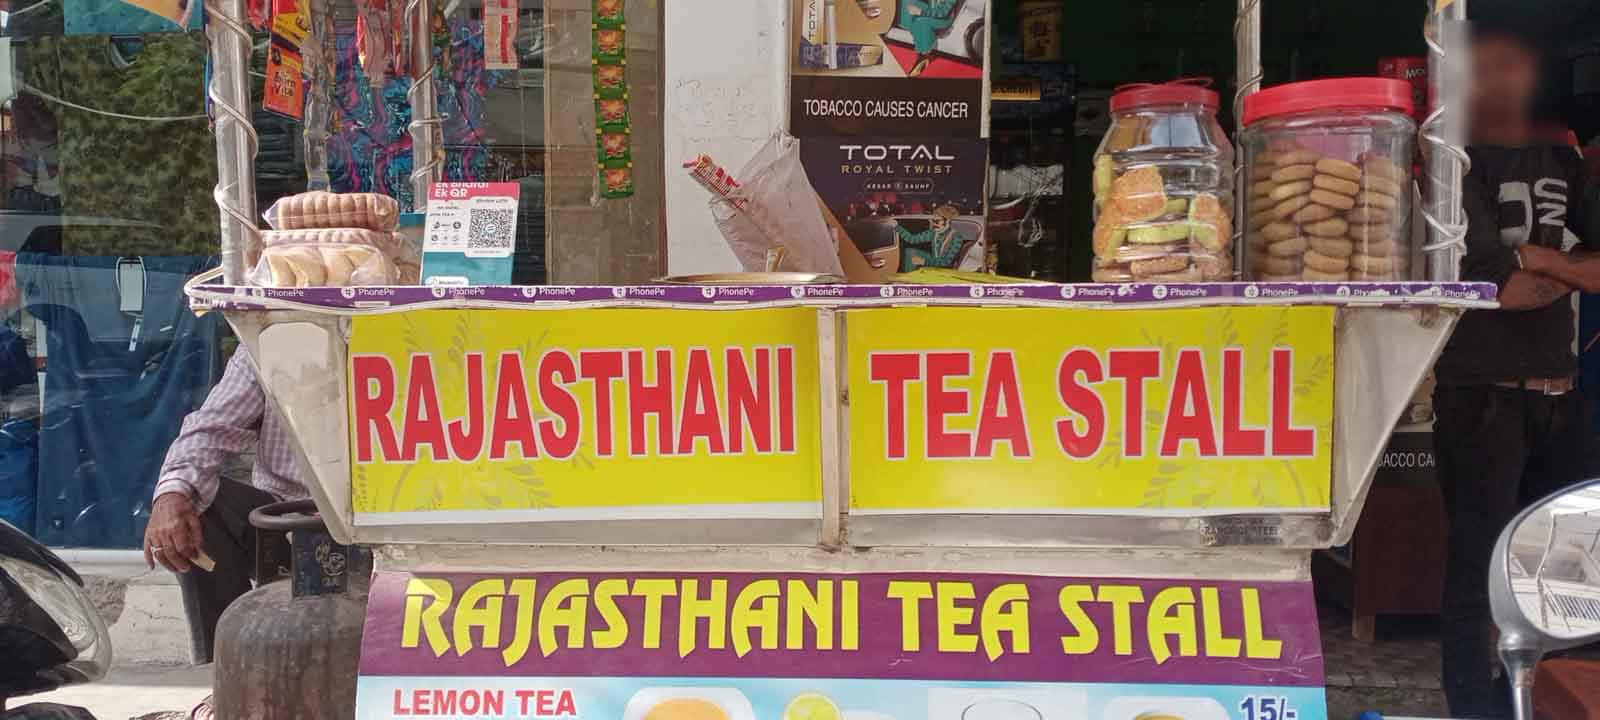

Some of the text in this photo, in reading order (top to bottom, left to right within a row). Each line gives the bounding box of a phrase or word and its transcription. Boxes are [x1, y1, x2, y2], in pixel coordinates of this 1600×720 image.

[808, 1, 816, 40] TOTA
[804, 99, 968, 118] TOBACCO CAUSES CANCER
[840, 145, 955, 160] TOTAL
[841, 165, 952, 174] ROYAL TWIST
[435, 188, 468, 197] Ek QR
[268, 289, 304, 297] PhonePe
[358, 288, 395, 297] PhonePe
[539, 288, 576, 296] PhonePe
[629, 288, 665, 296] PhonePe
[719, 288, 754, 296] PhonePe
[808, 288, 844, 296] PhonePe
[897, 288, 933, 296] PhonePe
[1170, 288, 1207, 296] PhonePe
[352, 347, 1316, 463] RAJASTHANI TEA STALL
[401, 578, 1283, 667] RAJASTHANI TEA STALL
[393, 690, 577, 716] LEMON TEA
